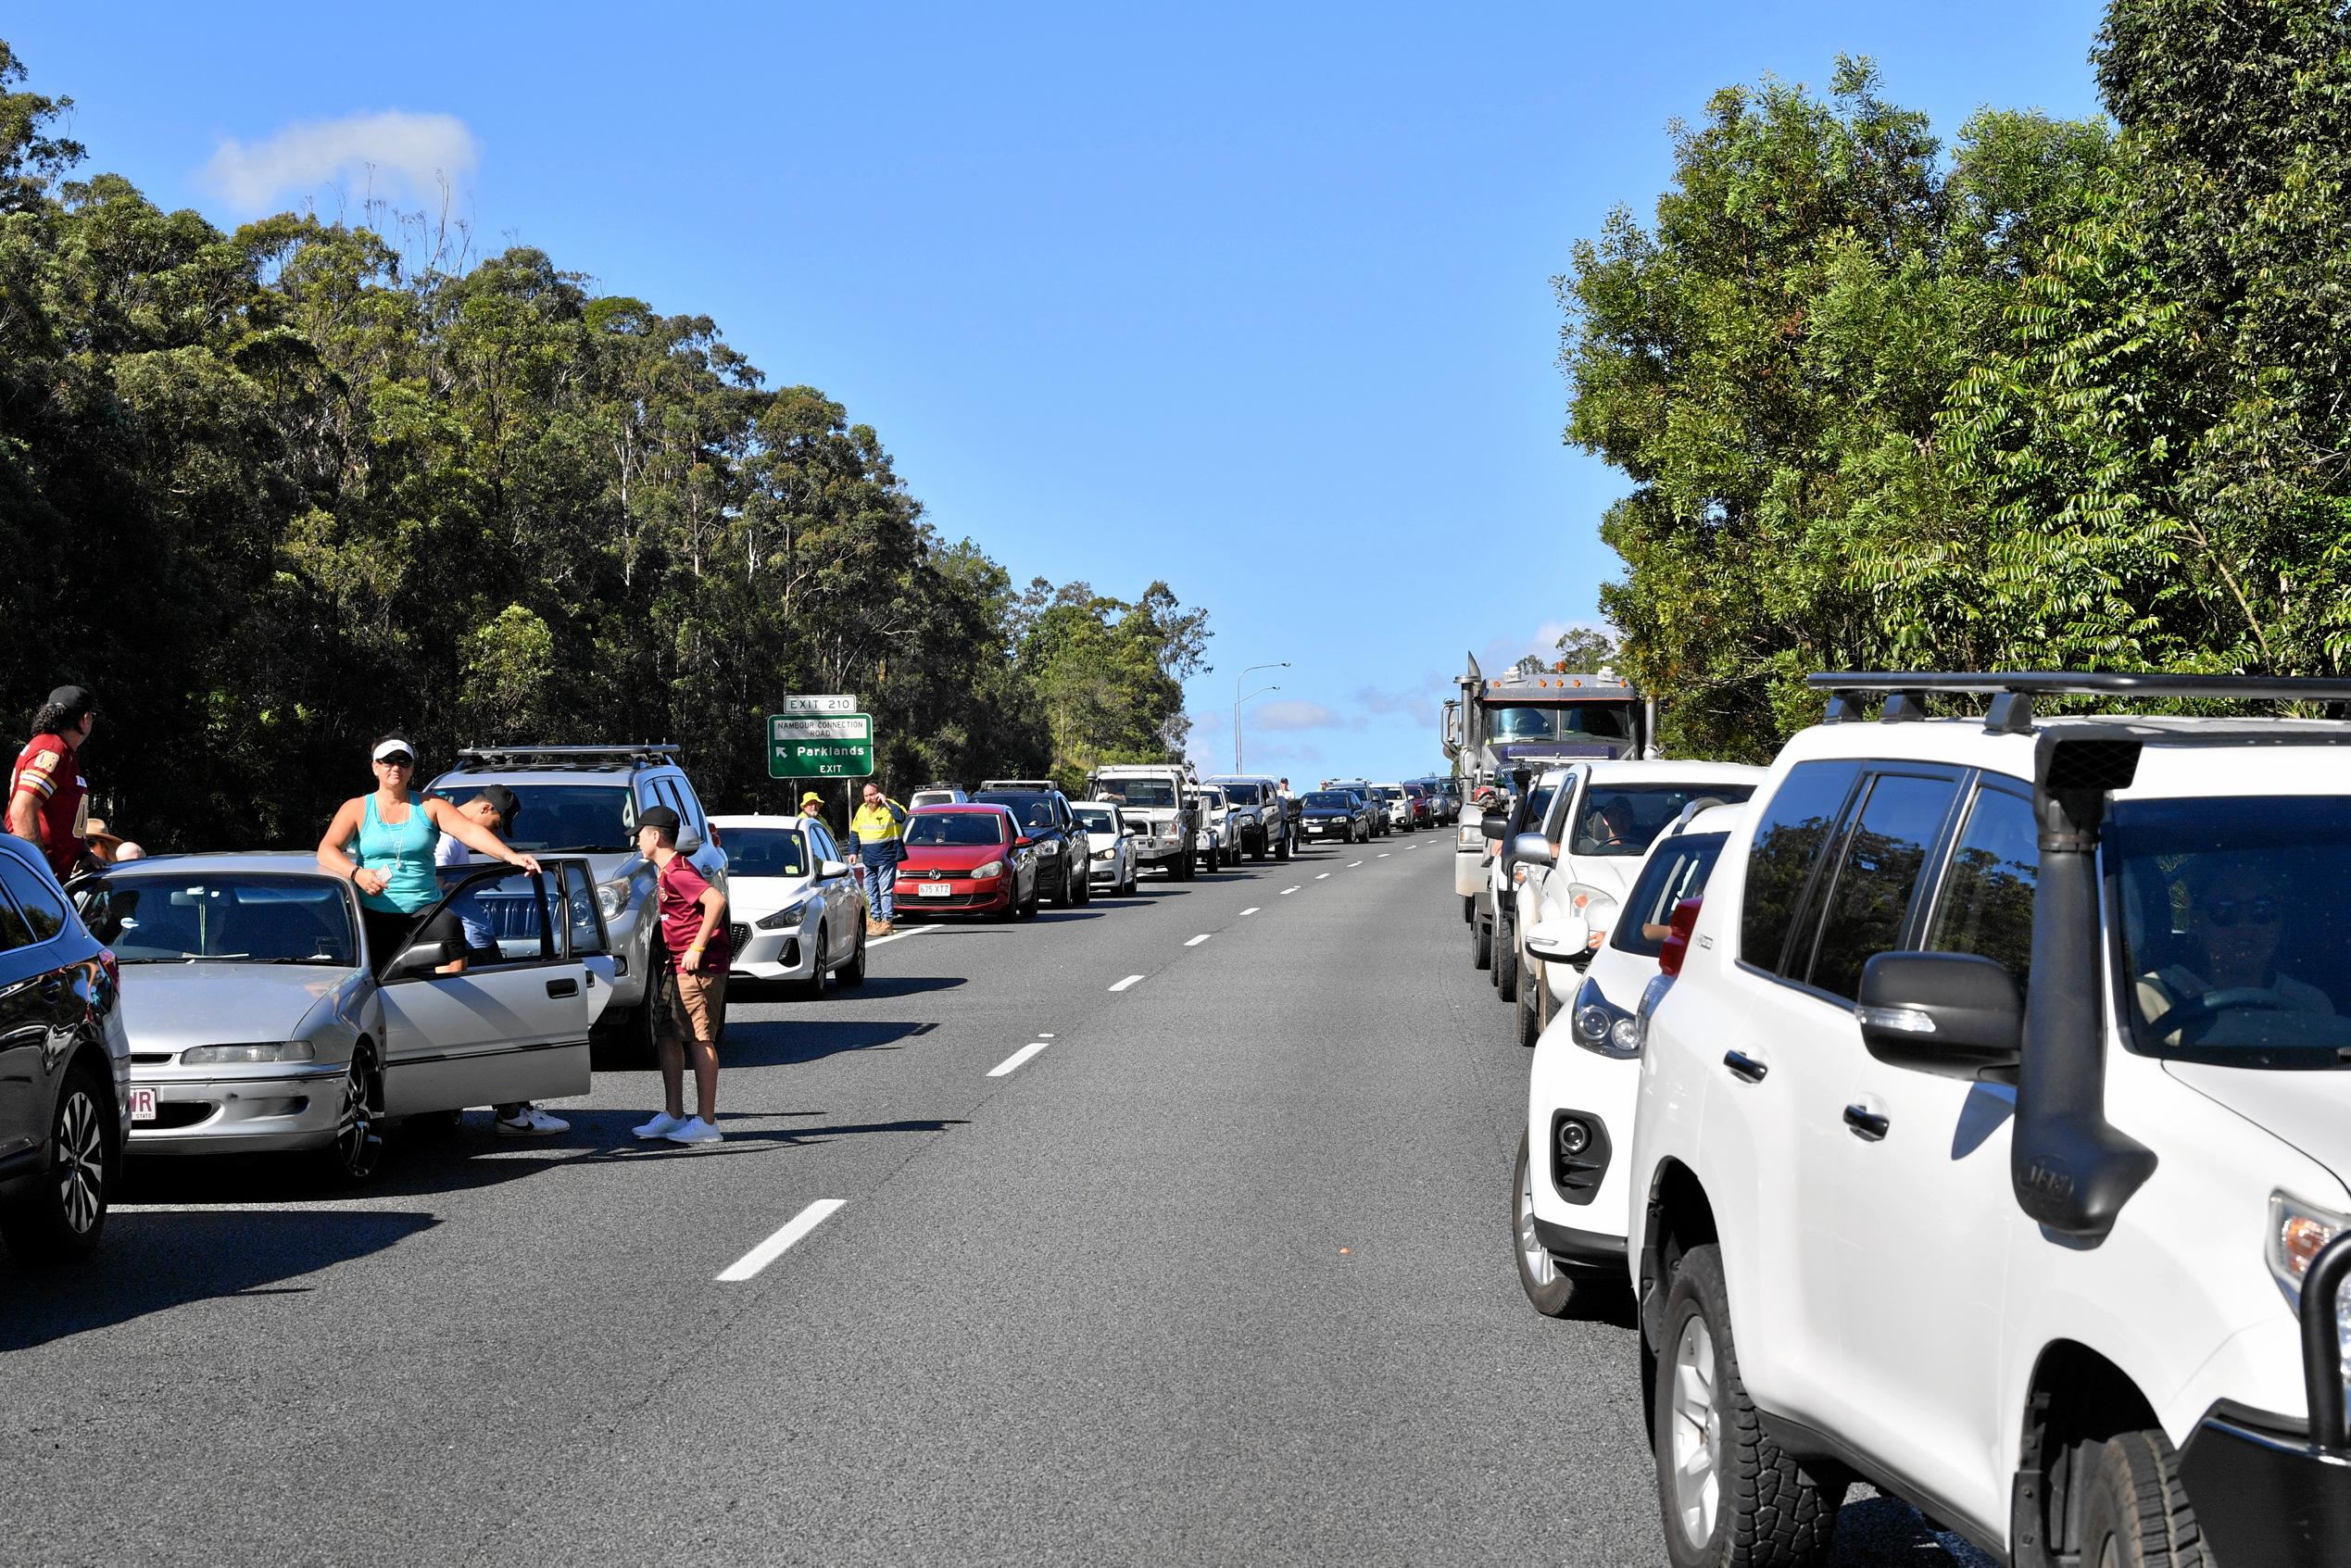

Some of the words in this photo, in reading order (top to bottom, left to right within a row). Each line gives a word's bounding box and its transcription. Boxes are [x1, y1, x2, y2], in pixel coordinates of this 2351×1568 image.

[790, 700, 820, 709] EXIT
[828, 700, 849, 709] 210
[817, 721, 863, 729] CONNECTION
[797, 746, 865, 757] Parklands
[819, 764, 843, 773] EXIT
